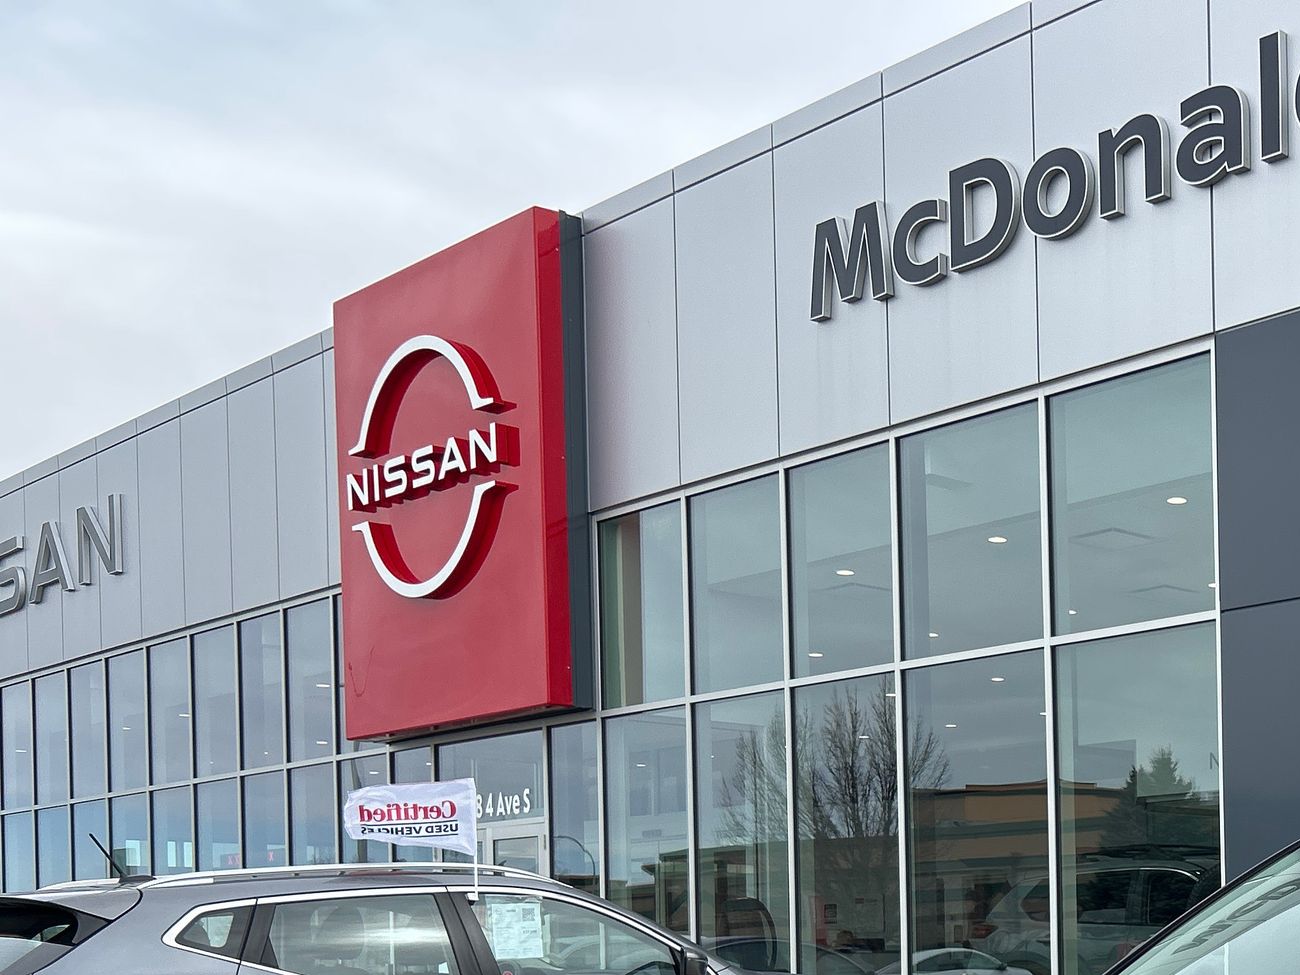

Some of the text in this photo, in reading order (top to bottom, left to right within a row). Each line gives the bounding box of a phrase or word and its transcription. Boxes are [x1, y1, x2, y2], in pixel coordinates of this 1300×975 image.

[346, 422, 498, 511] NISSAN
[496, 791, 521, 817] Ave
[523, 788, 531, 814] S
